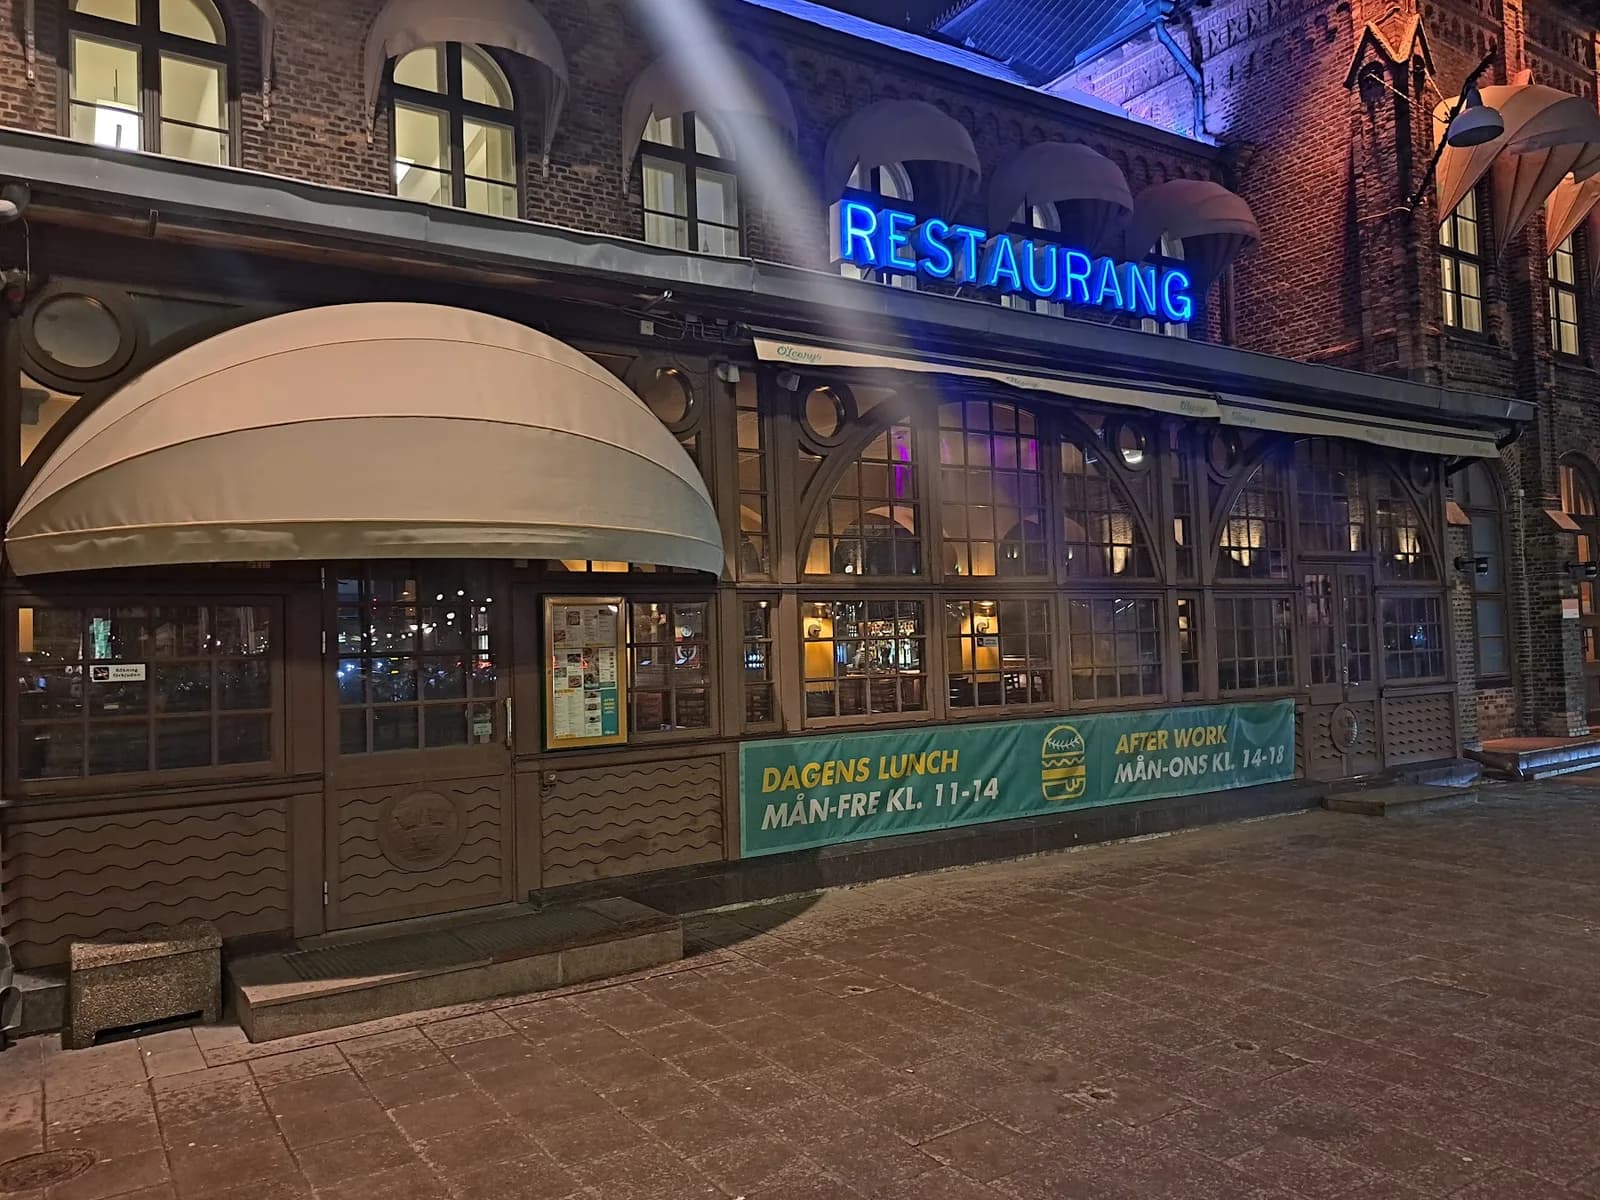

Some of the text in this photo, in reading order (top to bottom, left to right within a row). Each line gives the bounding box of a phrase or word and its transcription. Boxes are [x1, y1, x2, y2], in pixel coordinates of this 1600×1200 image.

[840, 201, 1193, 322] RESTAURANG
[1115, 724, 1228, 754] AFTER WORK
[762, 749, 960, 793] DAGENS LUNCH
[1113, 754, 1209, 784] MÅN-ONS
[1243, 745, 1285, 769] 14-18
[761, 777, 999, 830] MÅN-FRE KL. 11-14
